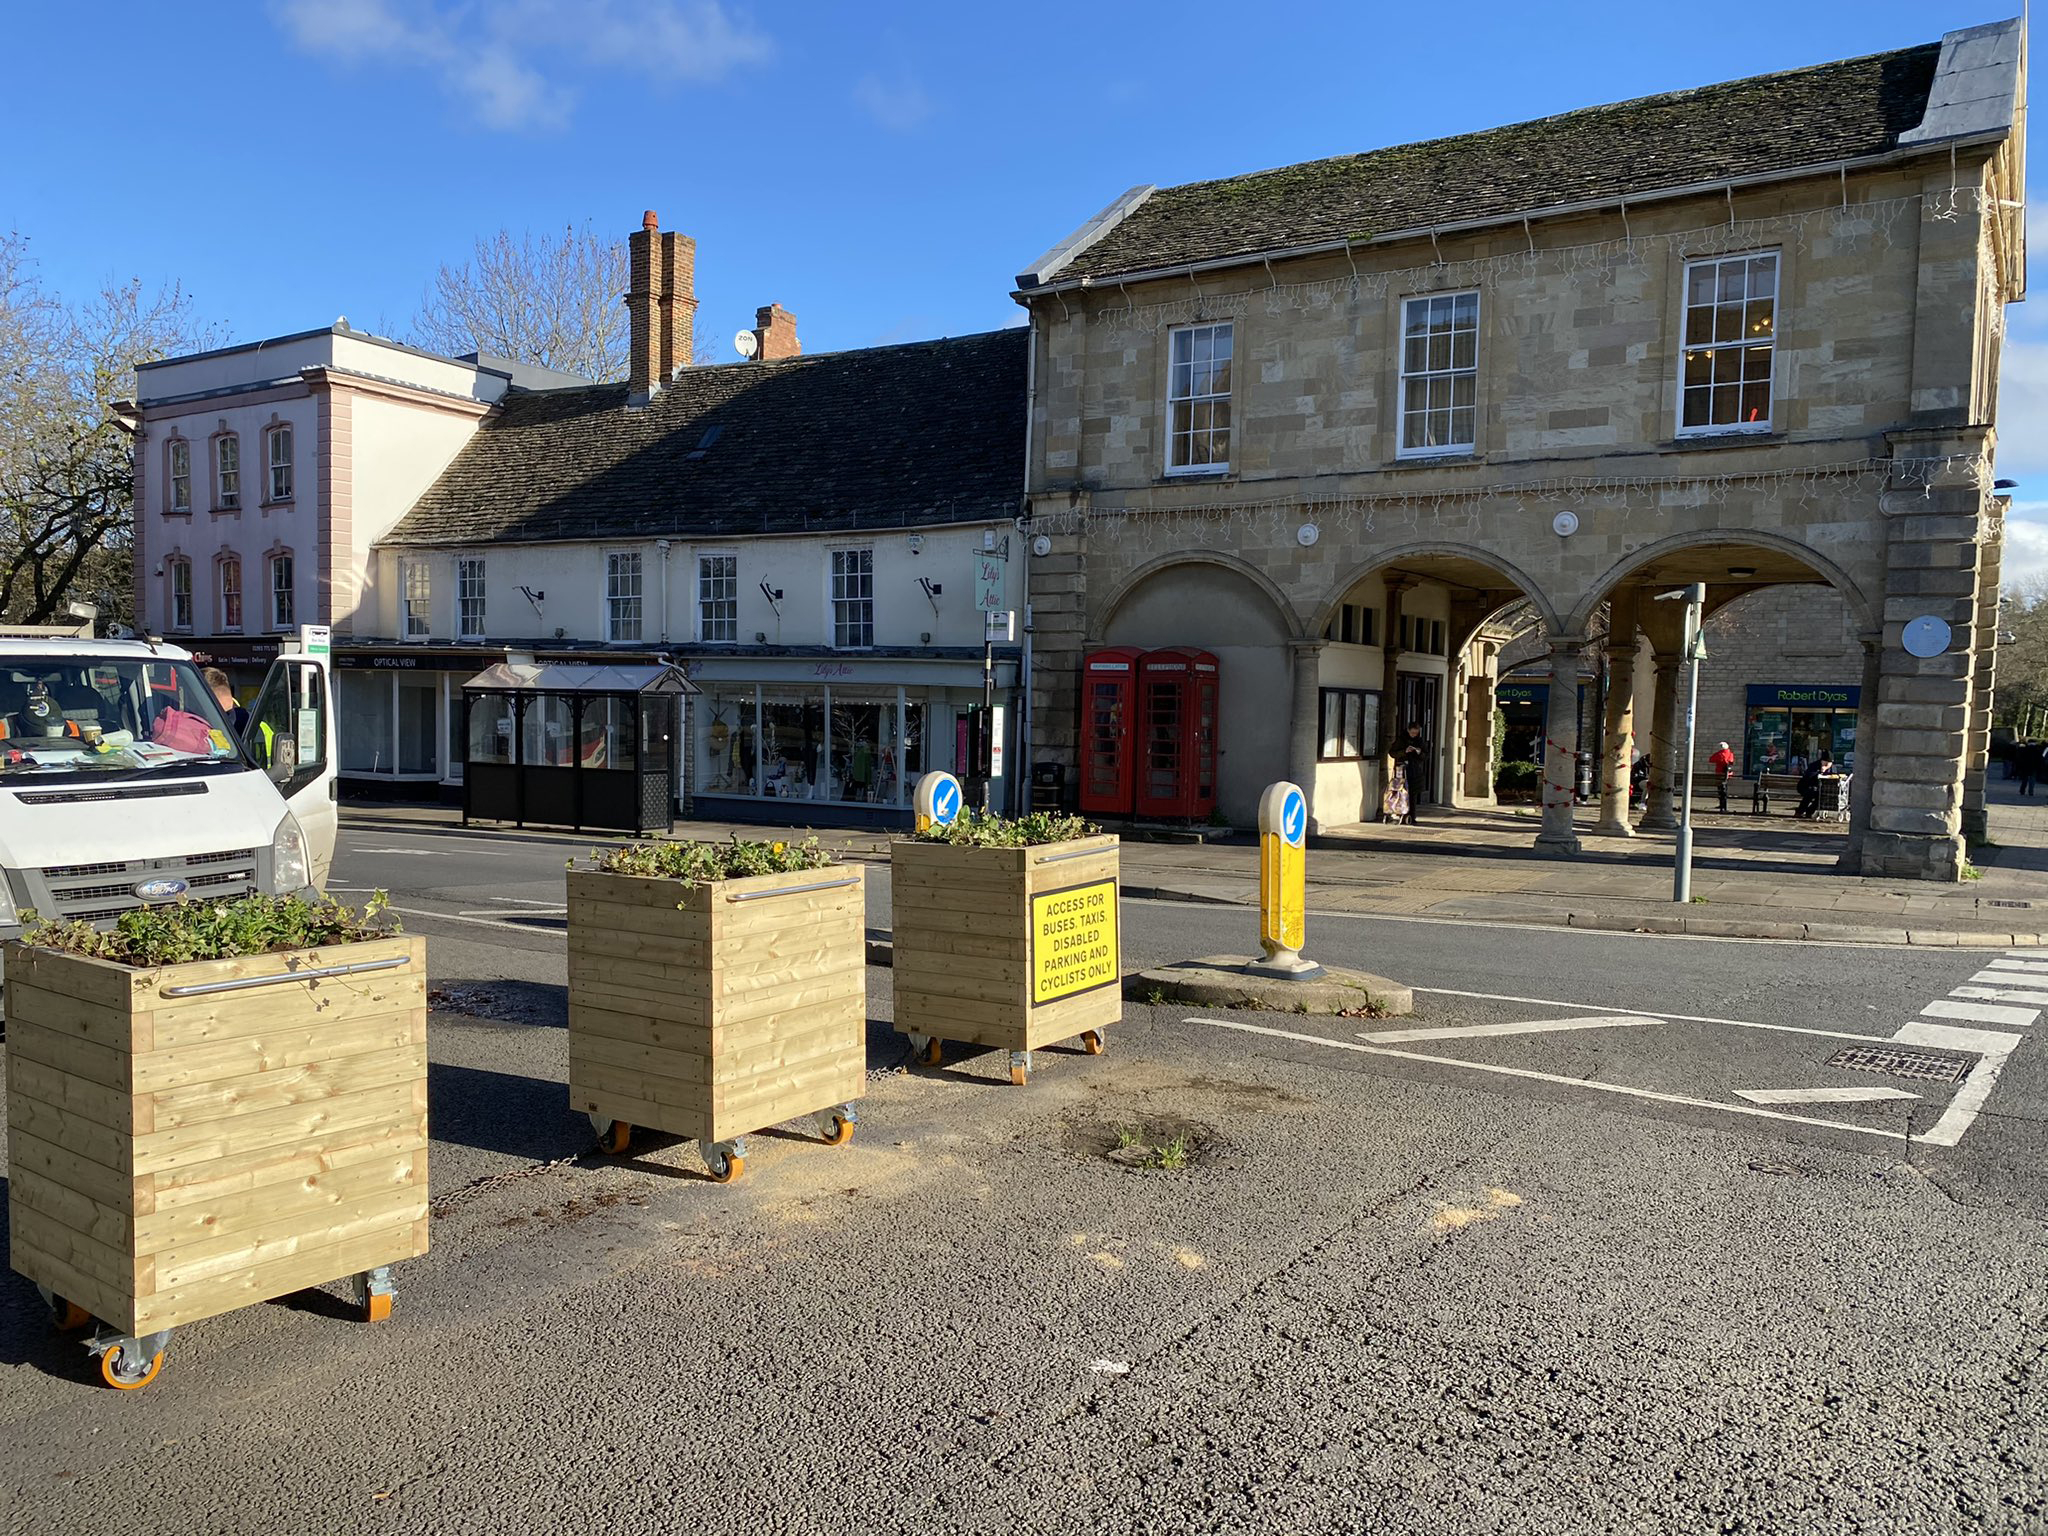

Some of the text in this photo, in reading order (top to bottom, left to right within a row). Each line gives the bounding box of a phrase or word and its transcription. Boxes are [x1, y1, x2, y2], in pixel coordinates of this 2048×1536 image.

[980, 562, 1000, 587] Lily's
[980, 588, 1000, 607] Attic
[194, 651, 213, 665] Chips
[373, 658, 416, 667] OPTICAL VIEW
[1511, 689, 1532, 698] Dyas
[1777, 690, 1848, 703] Robert Dyas
[151, 881, 179, 894] Ford
[1046, 893, 1105, 917] ACCESS FOR
[1053, 929, 1100, 952] DISABLED
[1044, 944, 1109, 973] PARKING AND
[1040, 960, 1112, 992] CYCLISTS ONLY
